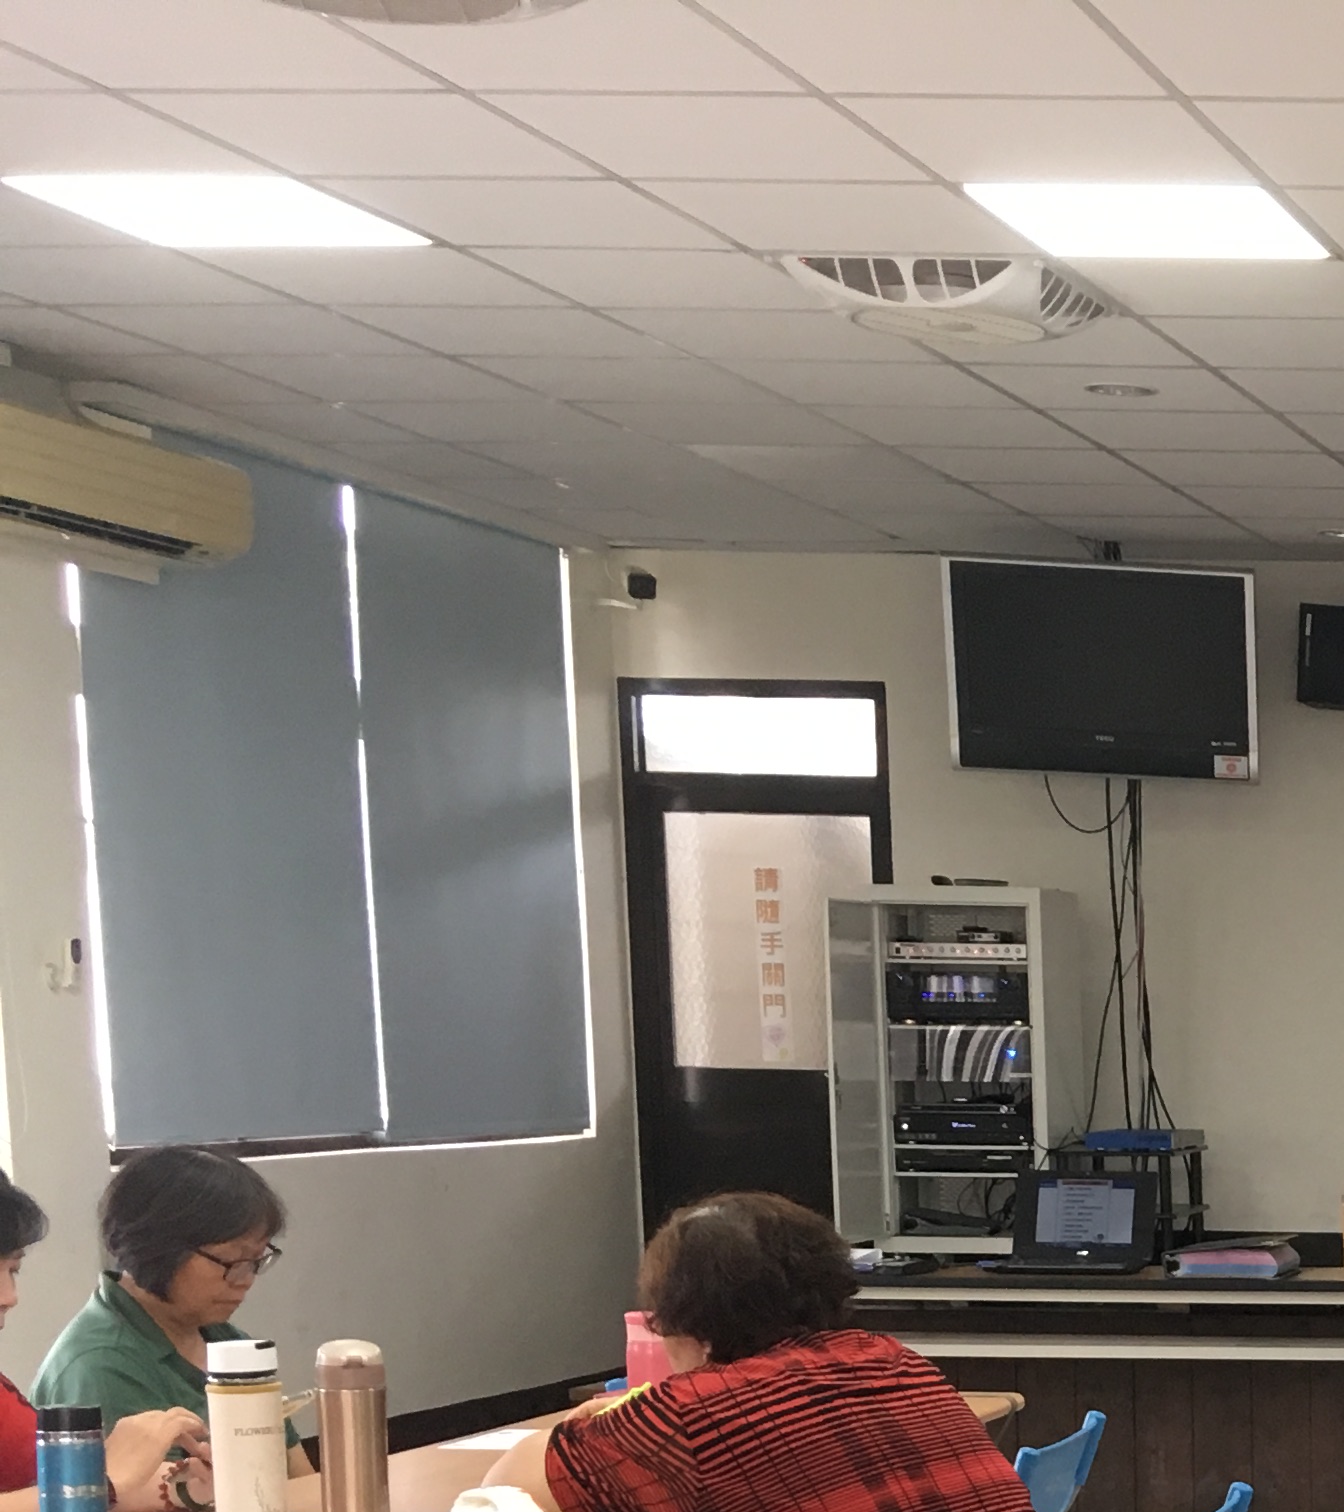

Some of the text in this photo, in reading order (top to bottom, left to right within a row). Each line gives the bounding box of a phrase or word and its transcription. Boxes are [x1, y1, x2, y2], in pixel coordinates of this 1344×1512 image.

[754, 867, 787, 1018] 請隨手關門
